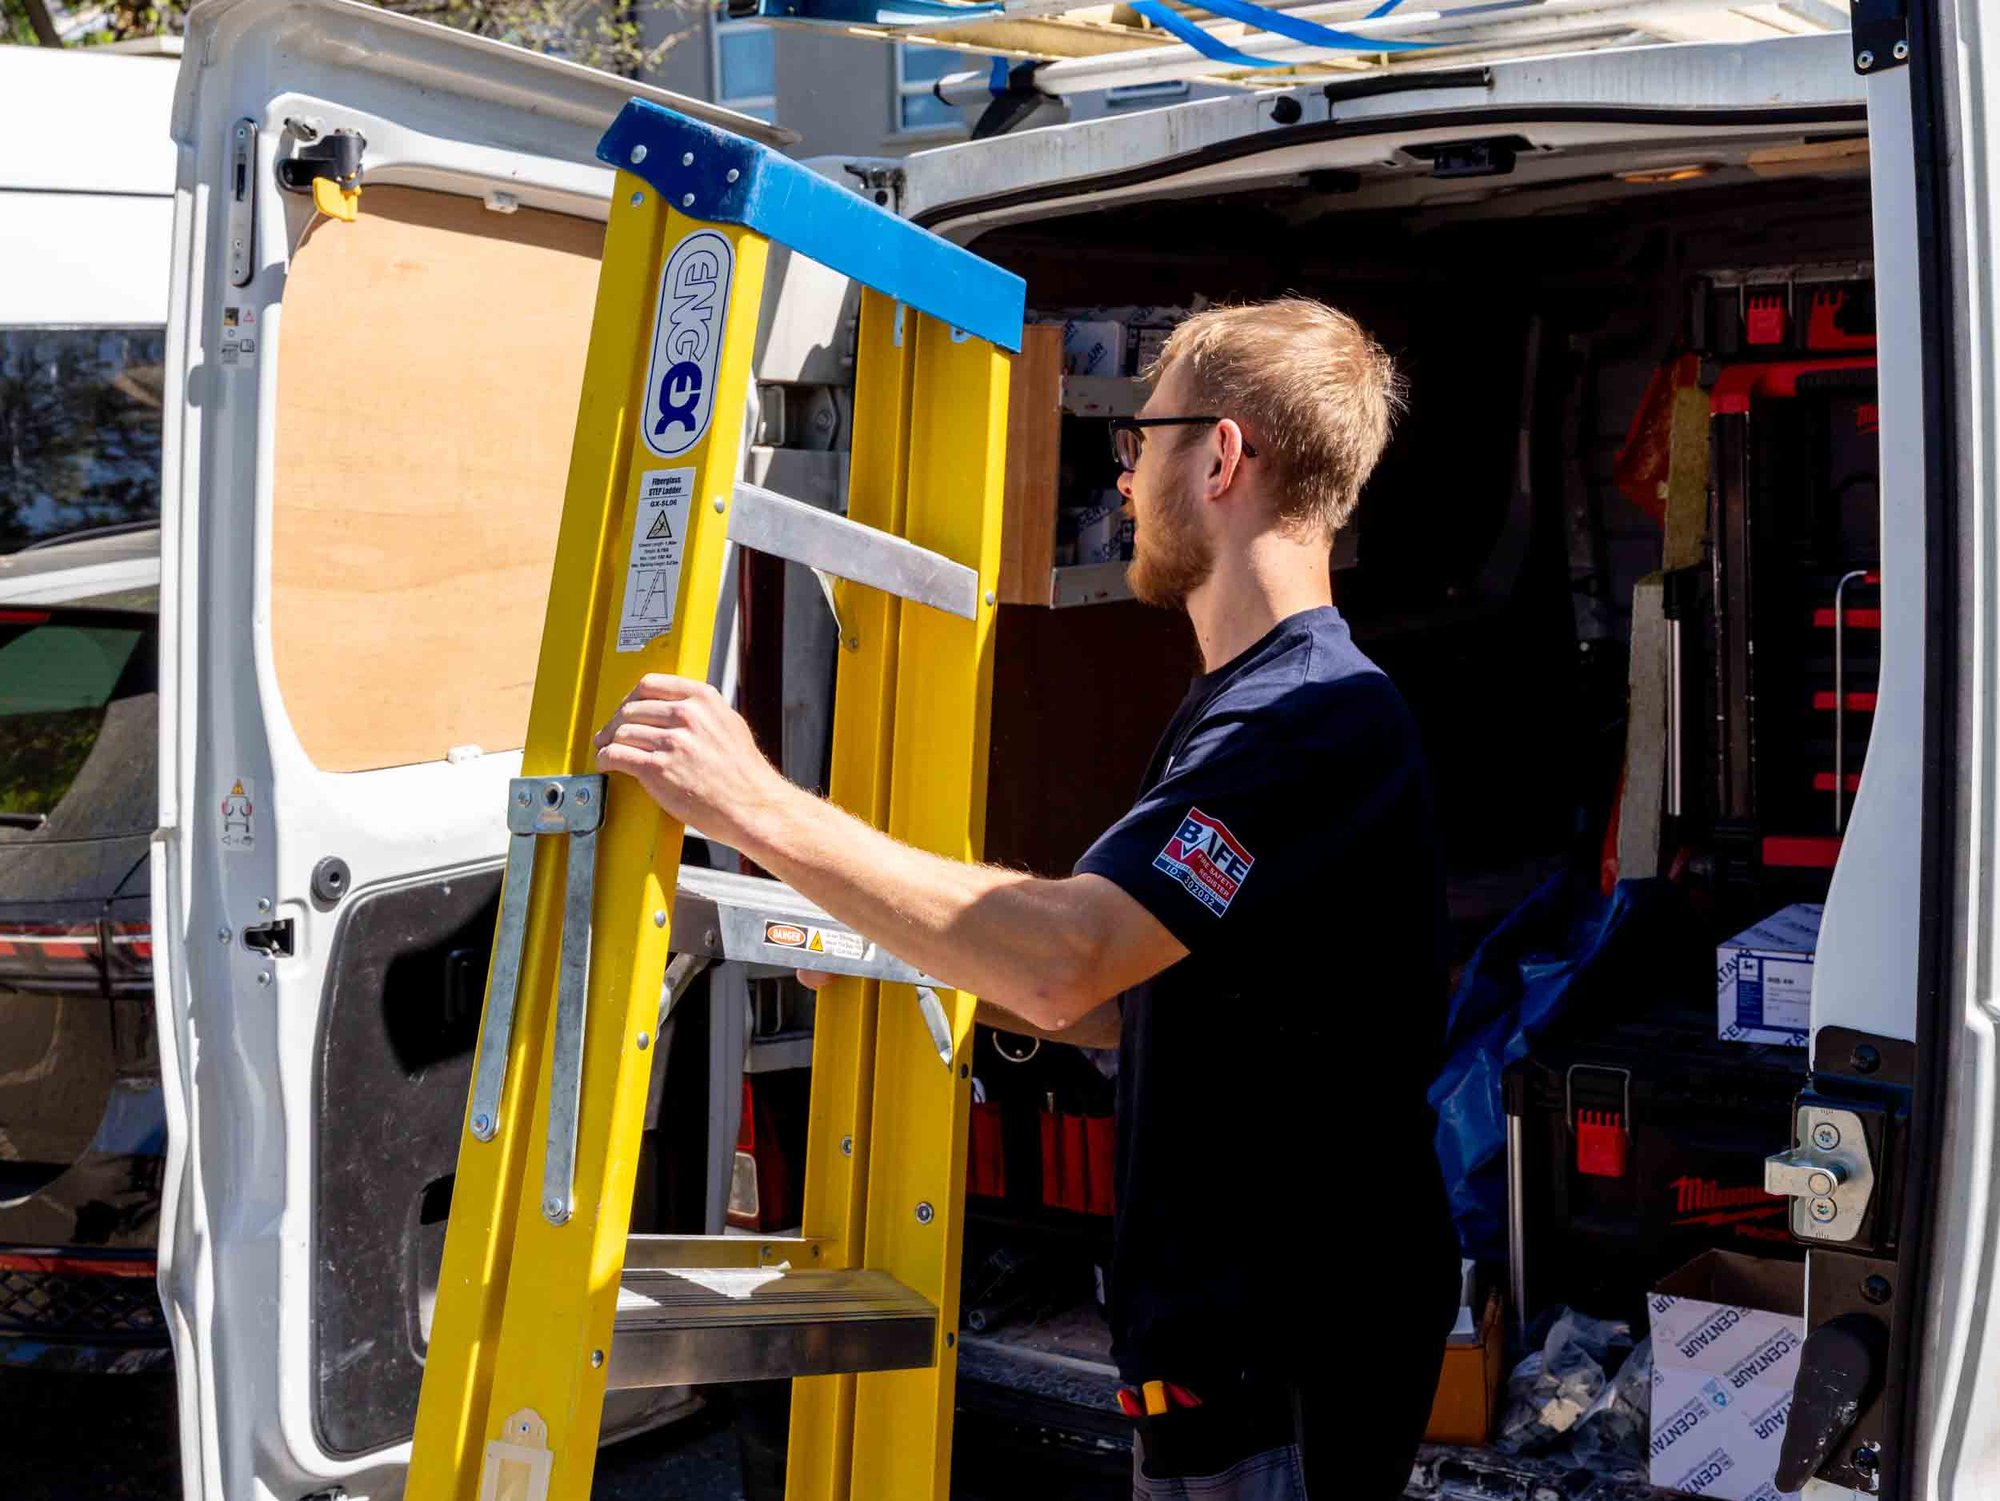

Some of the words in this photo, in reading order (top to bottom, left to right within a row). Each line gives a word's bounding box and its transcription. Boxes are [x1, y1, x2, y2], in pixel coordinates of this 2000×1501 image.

[648, 487, 662, 496] STEP
[662, 486, 682, 495] Ladder
[652, 476, 682, 487] Fiberglass
[650, 499, 677, 508] GX-SL06
[1176, 818, 1249, 885] BAFE
[1166, 864, 1182, 878] ID:
[1184, 875, 1215, 906] 302092
[1197, 854, 1210, 870] FIRE
[1209, 866, 1234, 890] SAFETY
[1199, 868, 1230, 898] REGISTER
[772, 928, 801, 941] DANGER
[1680, 1309, 1741, 1358] CENTAUR
[1730, 1340, 1790, 1389] CENTAUR
